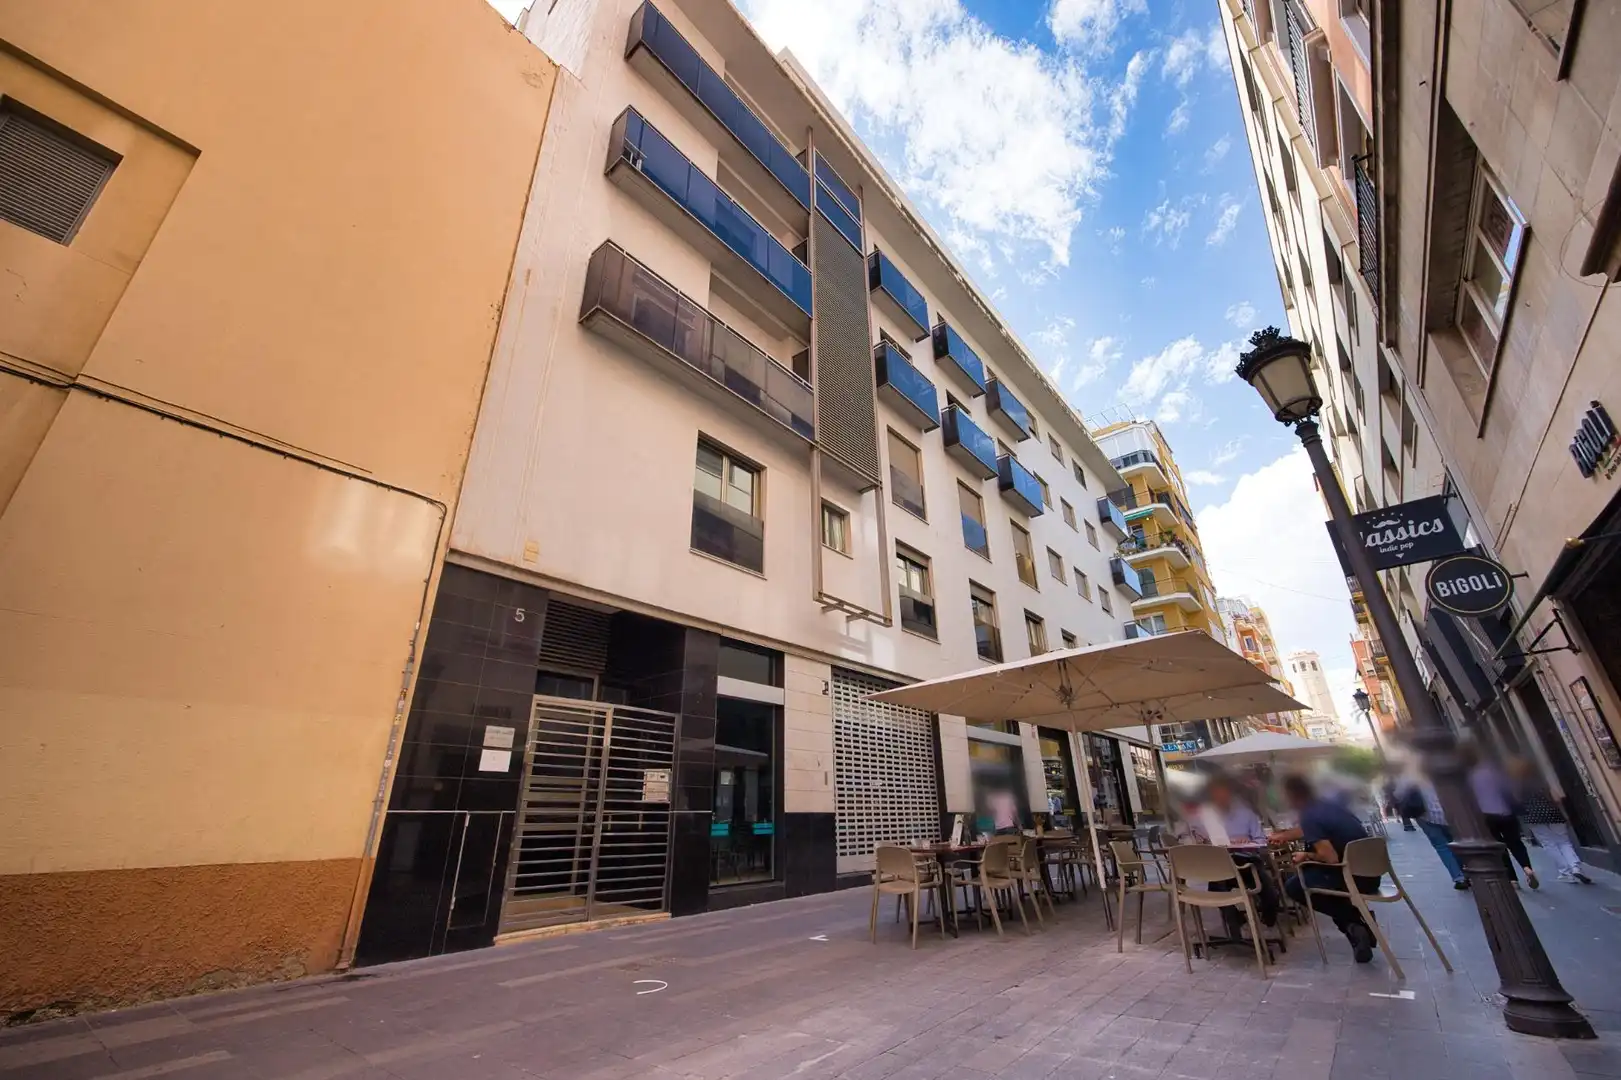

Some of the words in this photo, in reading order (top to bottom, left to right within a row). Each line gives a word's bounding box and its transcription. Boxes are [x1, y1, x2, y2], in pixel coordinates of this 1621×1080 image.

[1359, 518, 1445, 548] assics
[1379, 544, 1398, 553] indie
[1400, 541, 1414, 551] pop
[514, 607, 525, 622] 5
